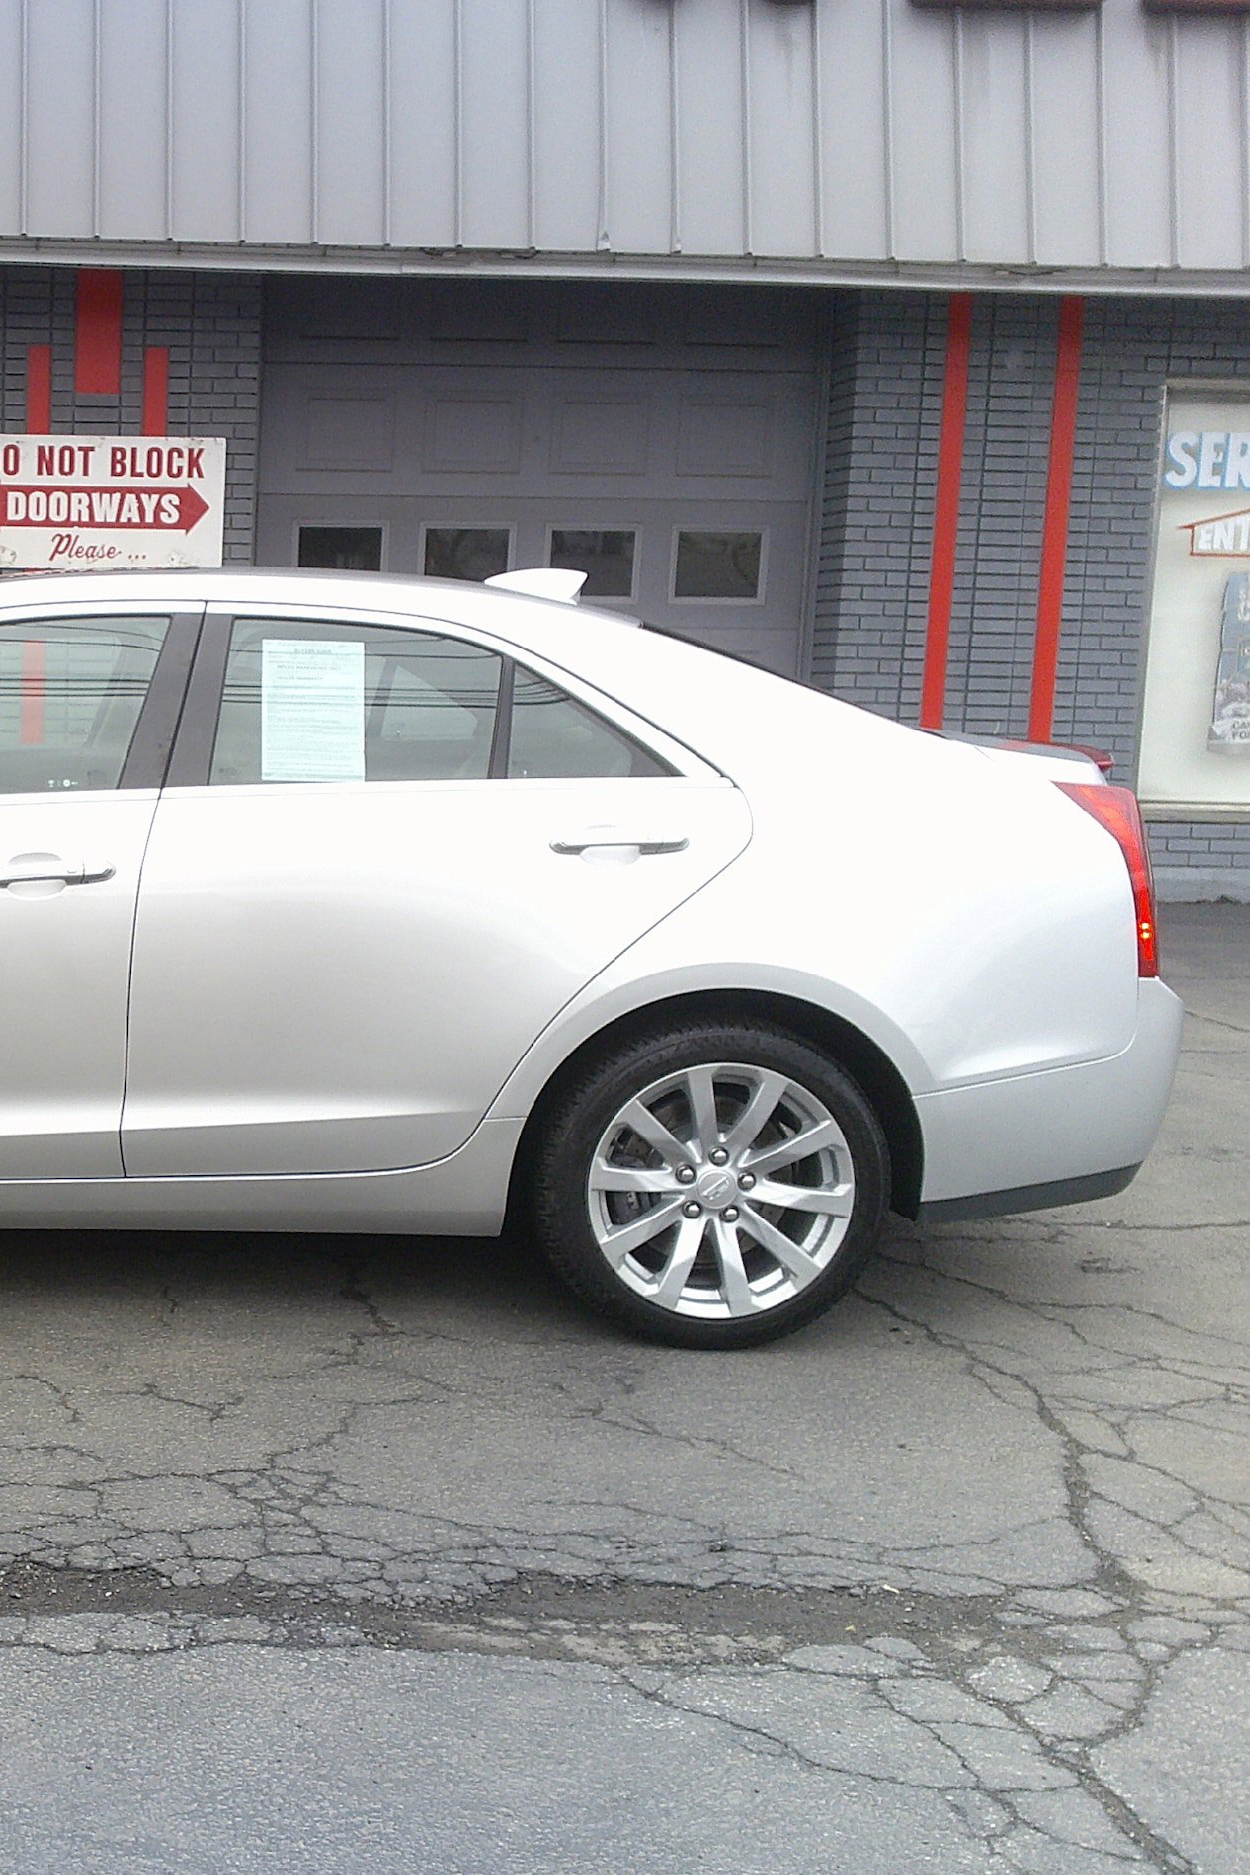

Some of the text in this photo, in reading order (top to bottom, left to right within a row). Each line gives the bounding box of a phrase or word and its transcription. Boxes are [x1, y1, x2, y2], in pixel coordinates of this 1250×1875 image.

[36, 445, 95, 477] NOT
[110, 446, 205, 479] BLOCK
[6, 491, 181, 524] DOORWAYS
